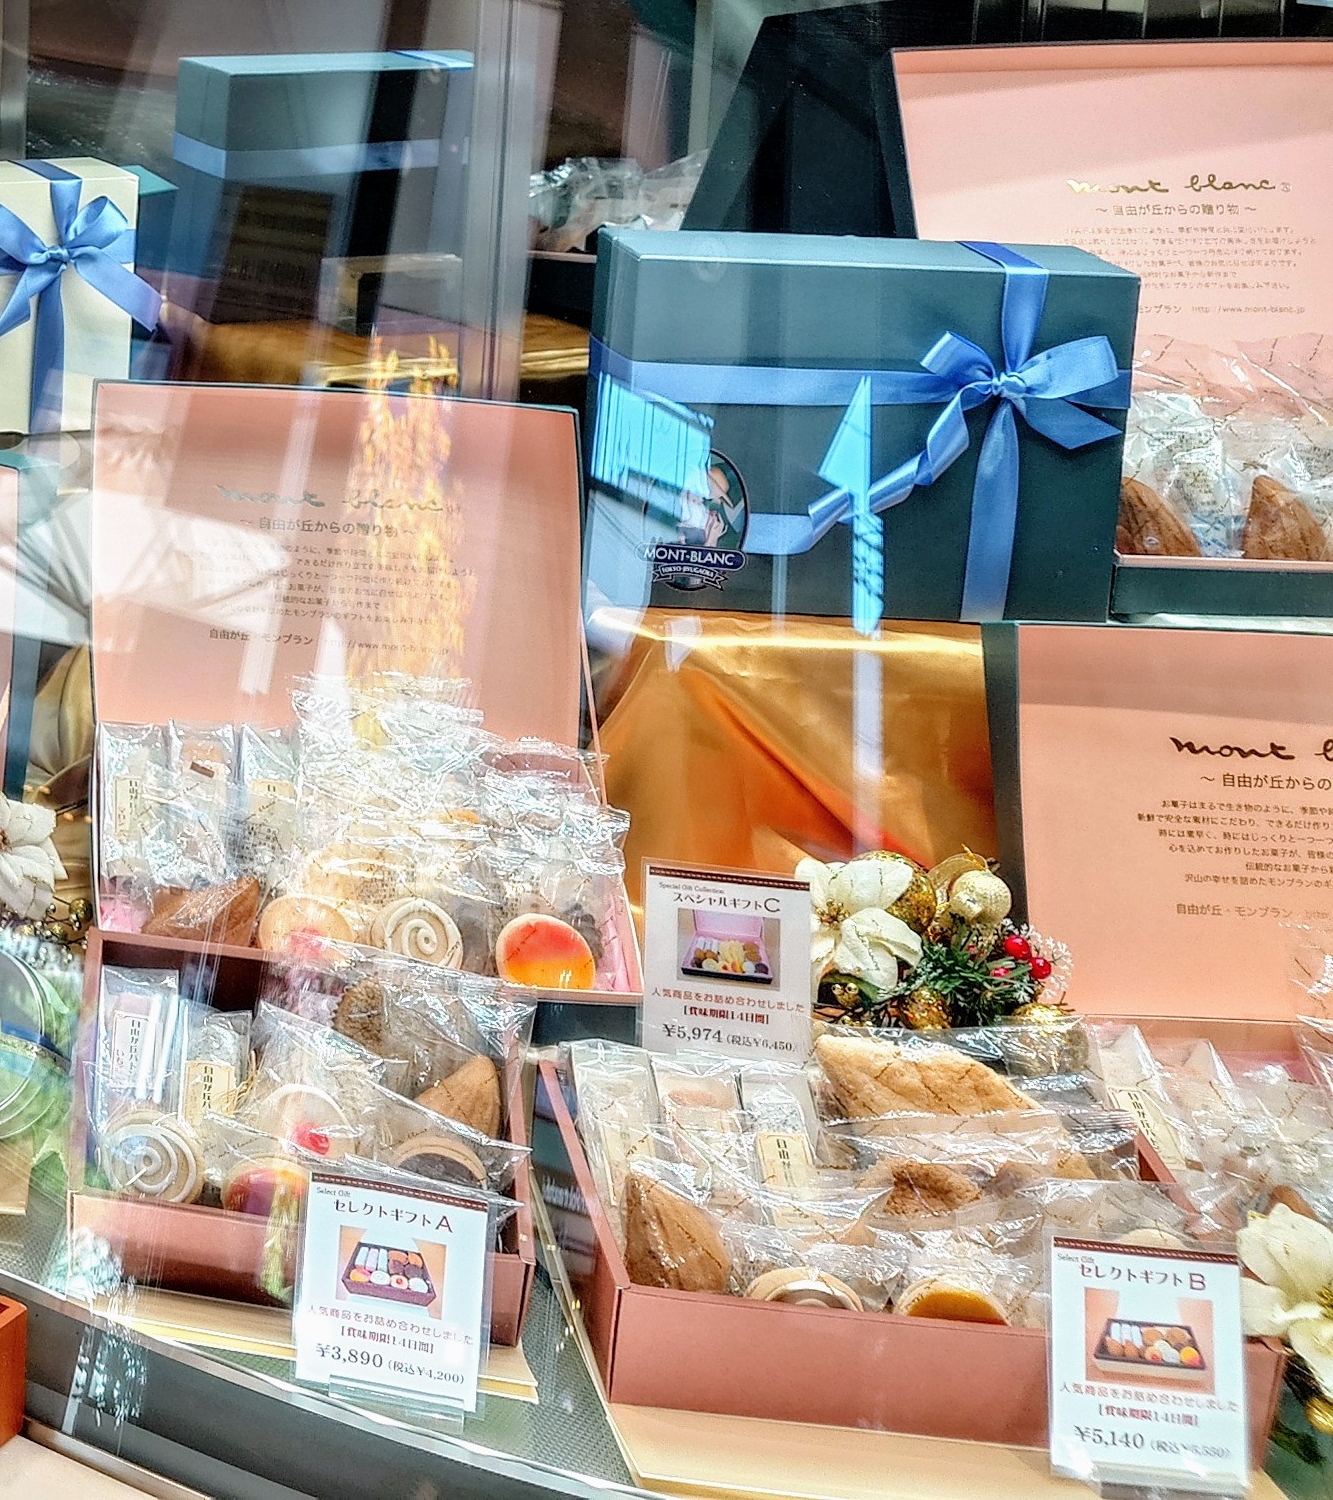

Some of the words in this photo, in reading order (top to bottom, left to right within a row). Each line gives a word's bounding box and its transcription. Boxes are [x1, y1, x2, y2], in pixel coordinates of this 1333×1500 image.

[1185, 173, 1276, 192] blanc
[643, 547, 735, 566] MONT-BLANC
[1170, 737, 1296, 760] mont
[662, 1024, 723, 1044] ¥5,974
[333, 1199, 454, 1234] セレクトギフトA
[315, 1342, 383, 1369] ¥3,890
[1074, 1425, 1145, 1449] ¥5,140
